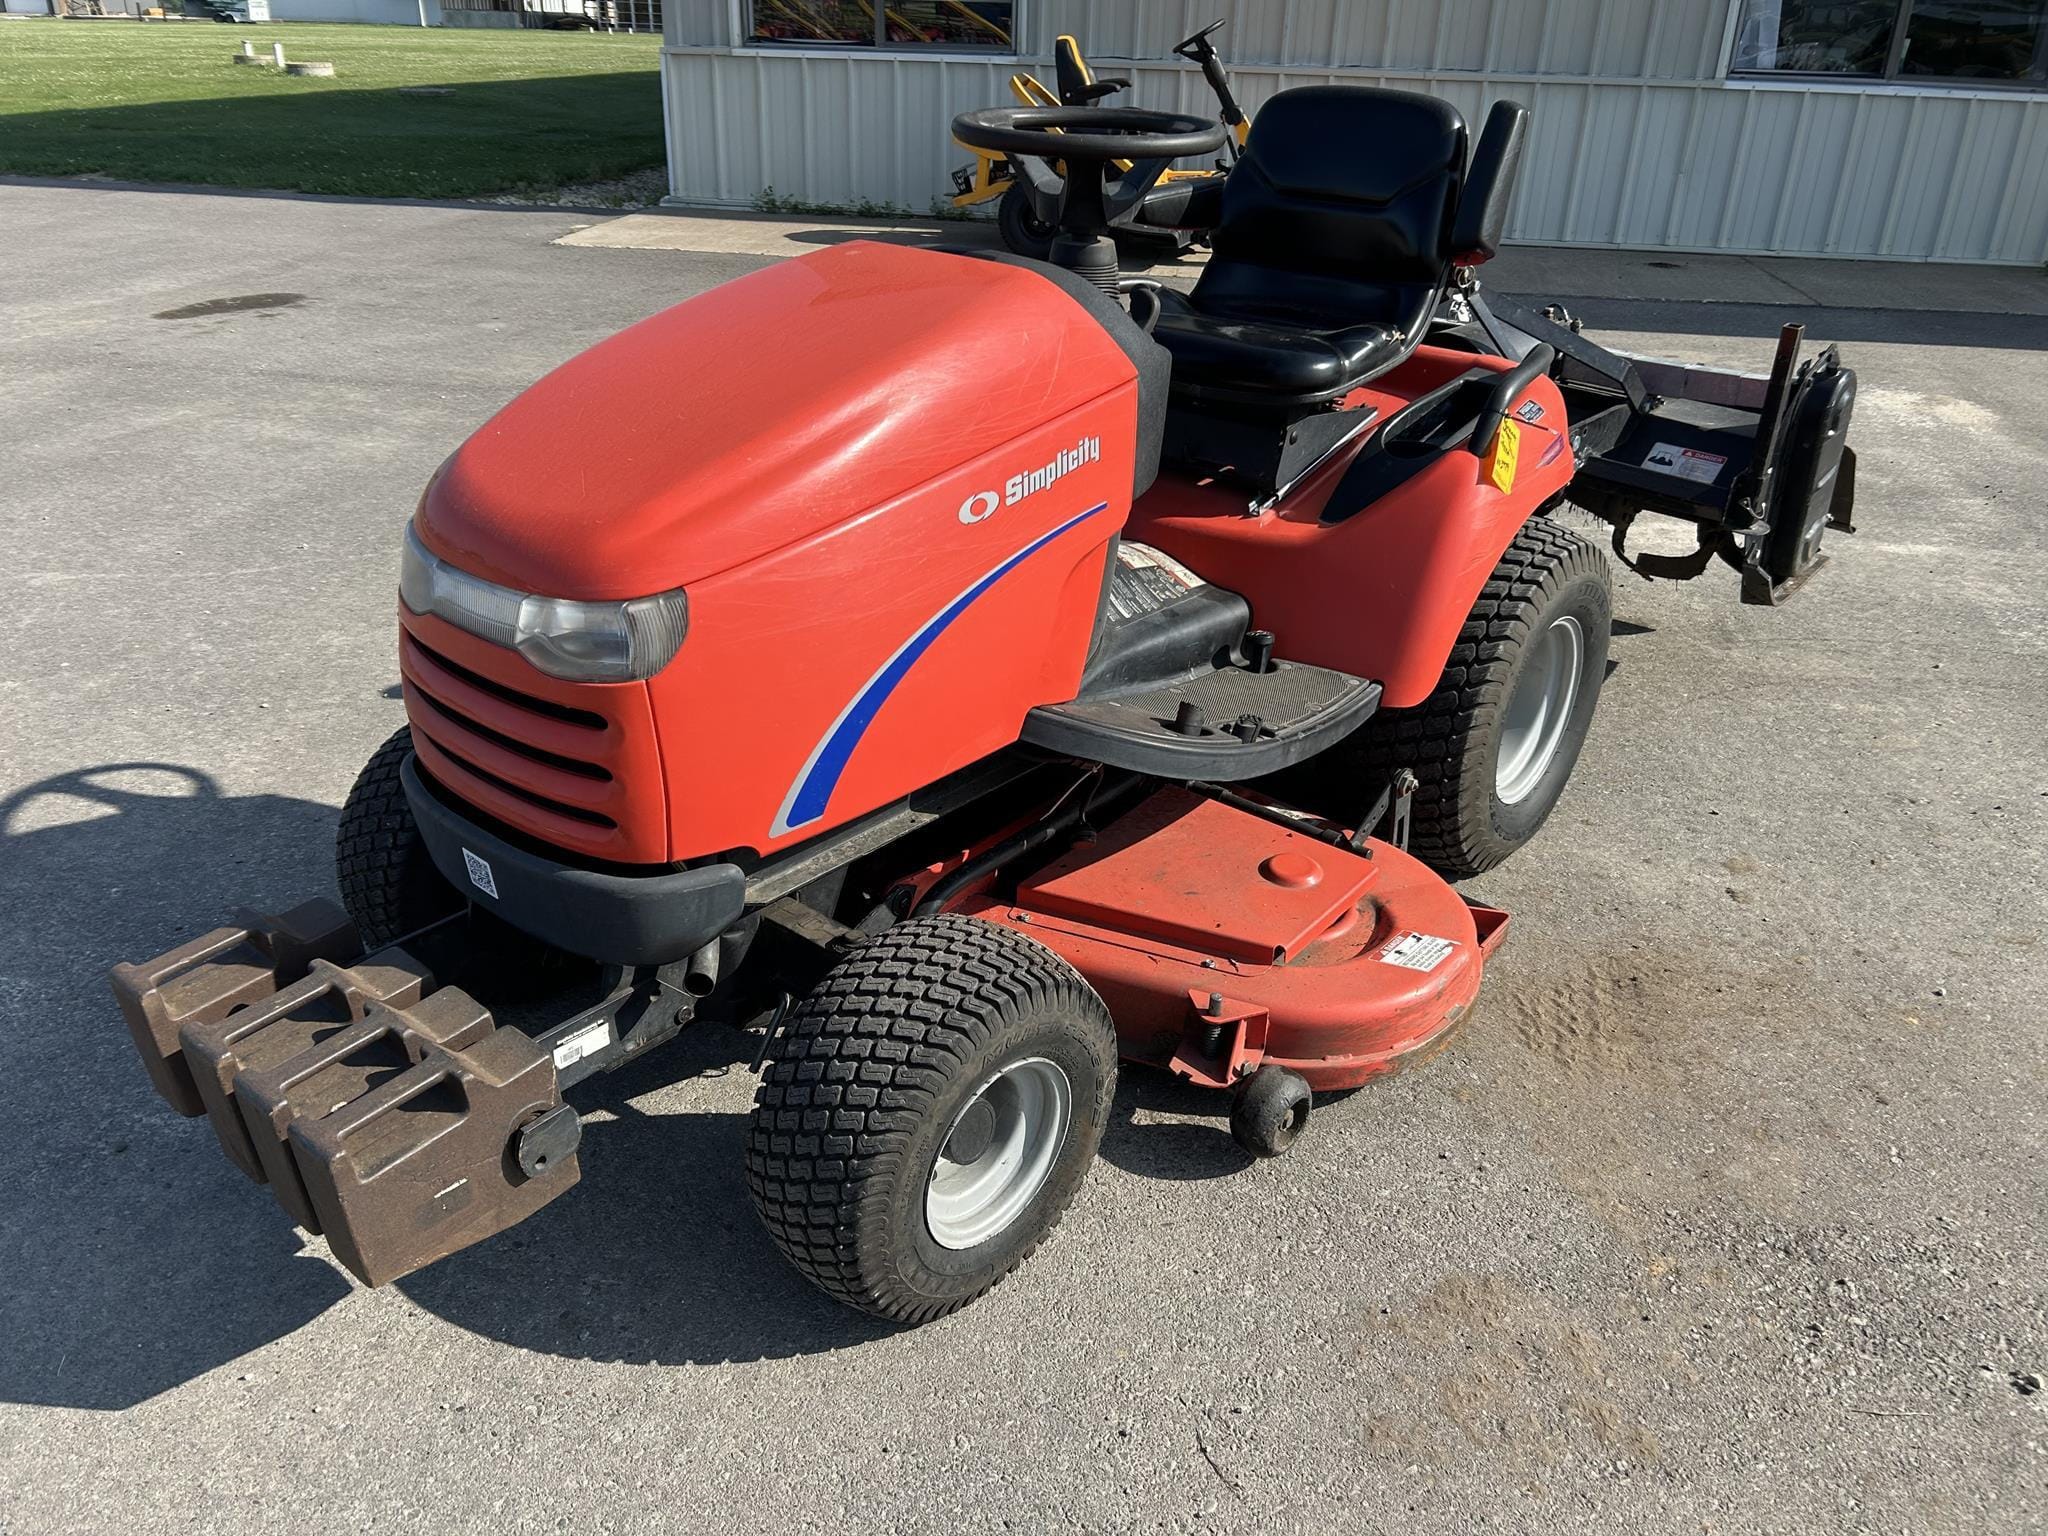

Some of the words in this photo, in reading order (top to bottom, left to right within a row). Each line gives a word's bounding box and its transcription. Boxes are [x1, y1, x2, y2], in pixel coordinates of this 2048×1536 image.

[1695, 452, 1723, 462] DANGER
[1005, 436, 1100, 507] Simplicity
[1384, 935, 1406, 952] DANGER
